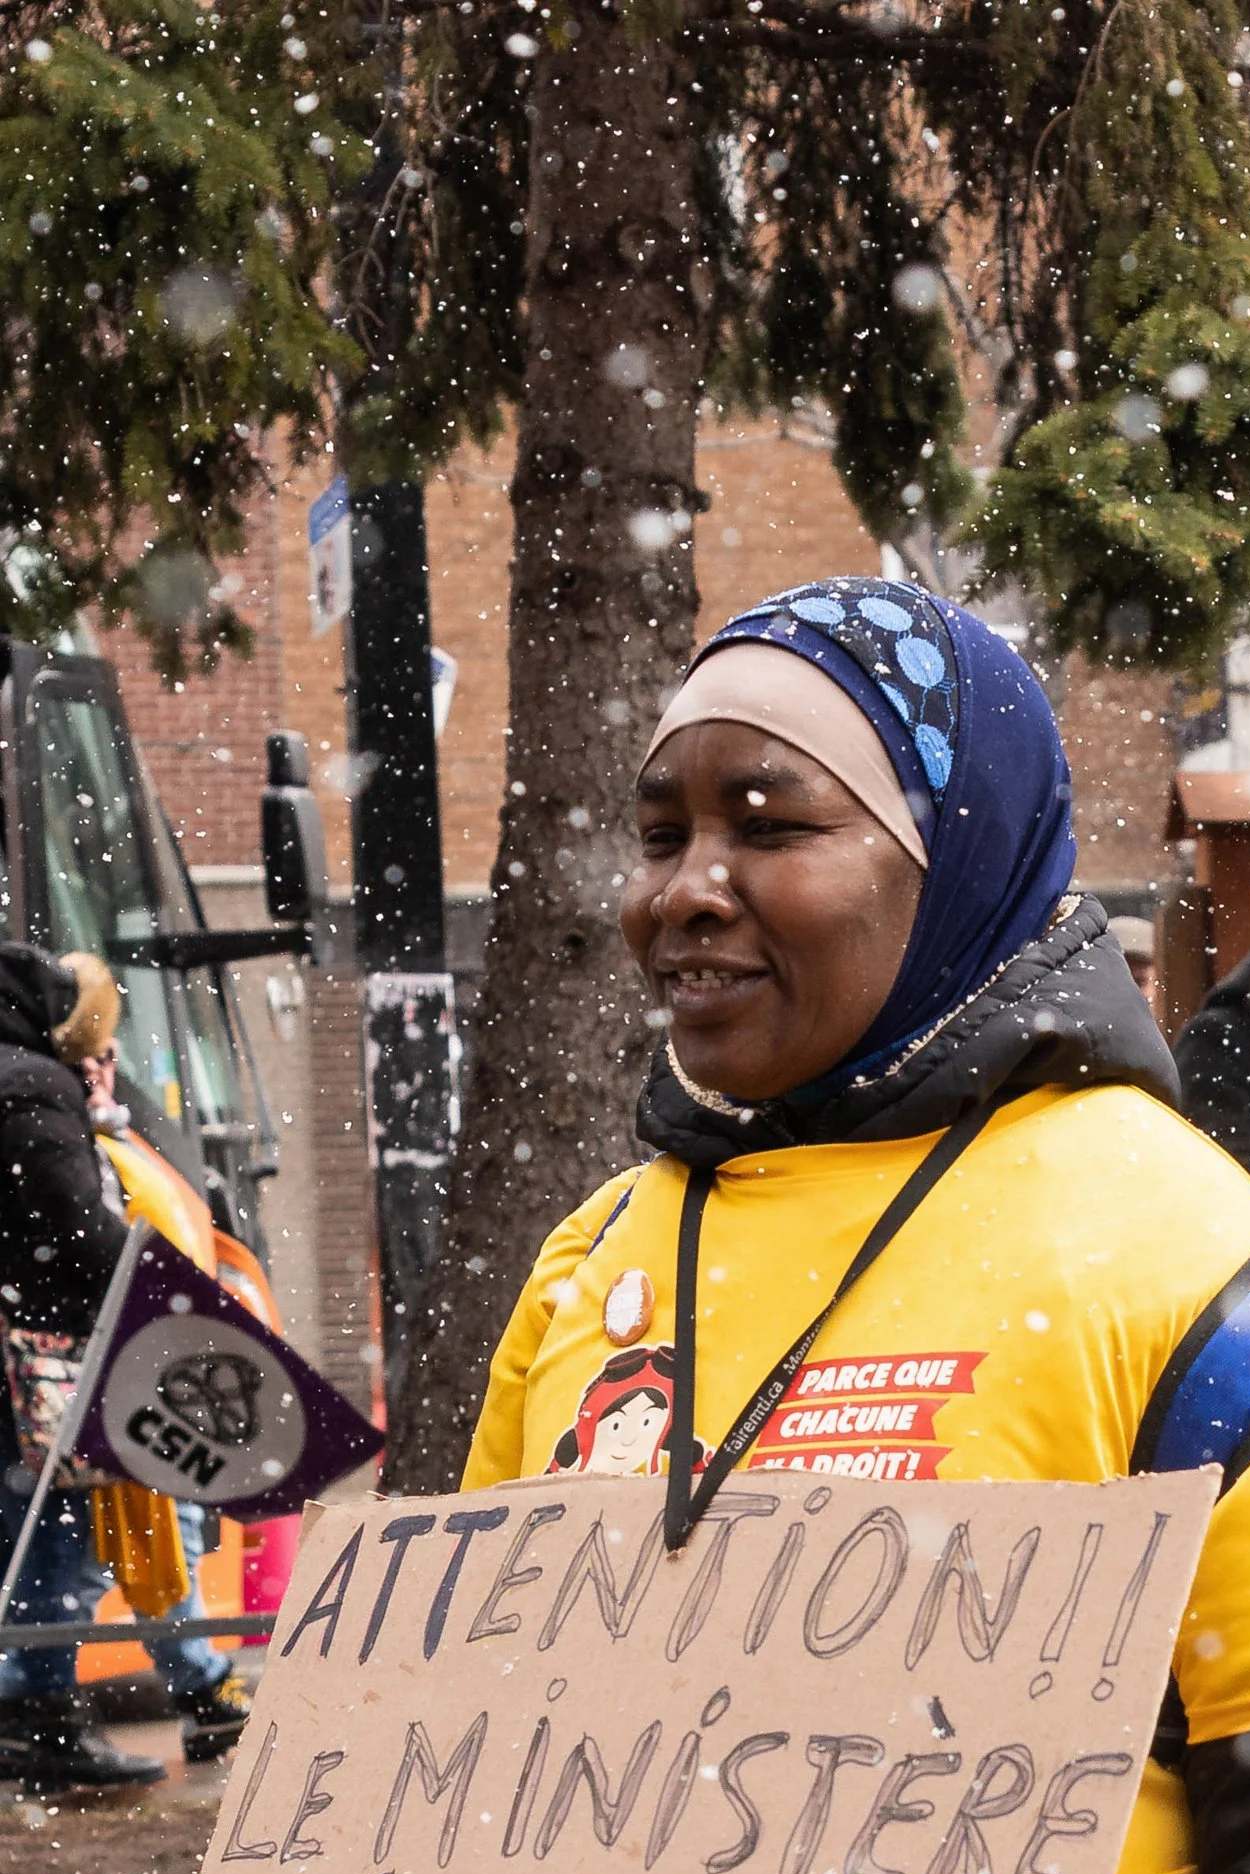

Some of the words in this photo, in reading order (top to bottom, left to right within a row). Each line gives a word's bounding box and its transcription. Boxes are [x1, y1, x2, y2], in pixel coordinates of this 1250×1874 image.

[797, 1363, 892, 1395] PARCE
[894, 1360, 958, 1389] QUE
[725, 1380, 784, 1454] fairemtl.ca
[780, 1404, 918, 1438] CHACUNE
[126, 1407, 226, 1487] CSN
[811, 1451, 921, 1481] DROIT!
[221, 1720, 348, 1865] LE
